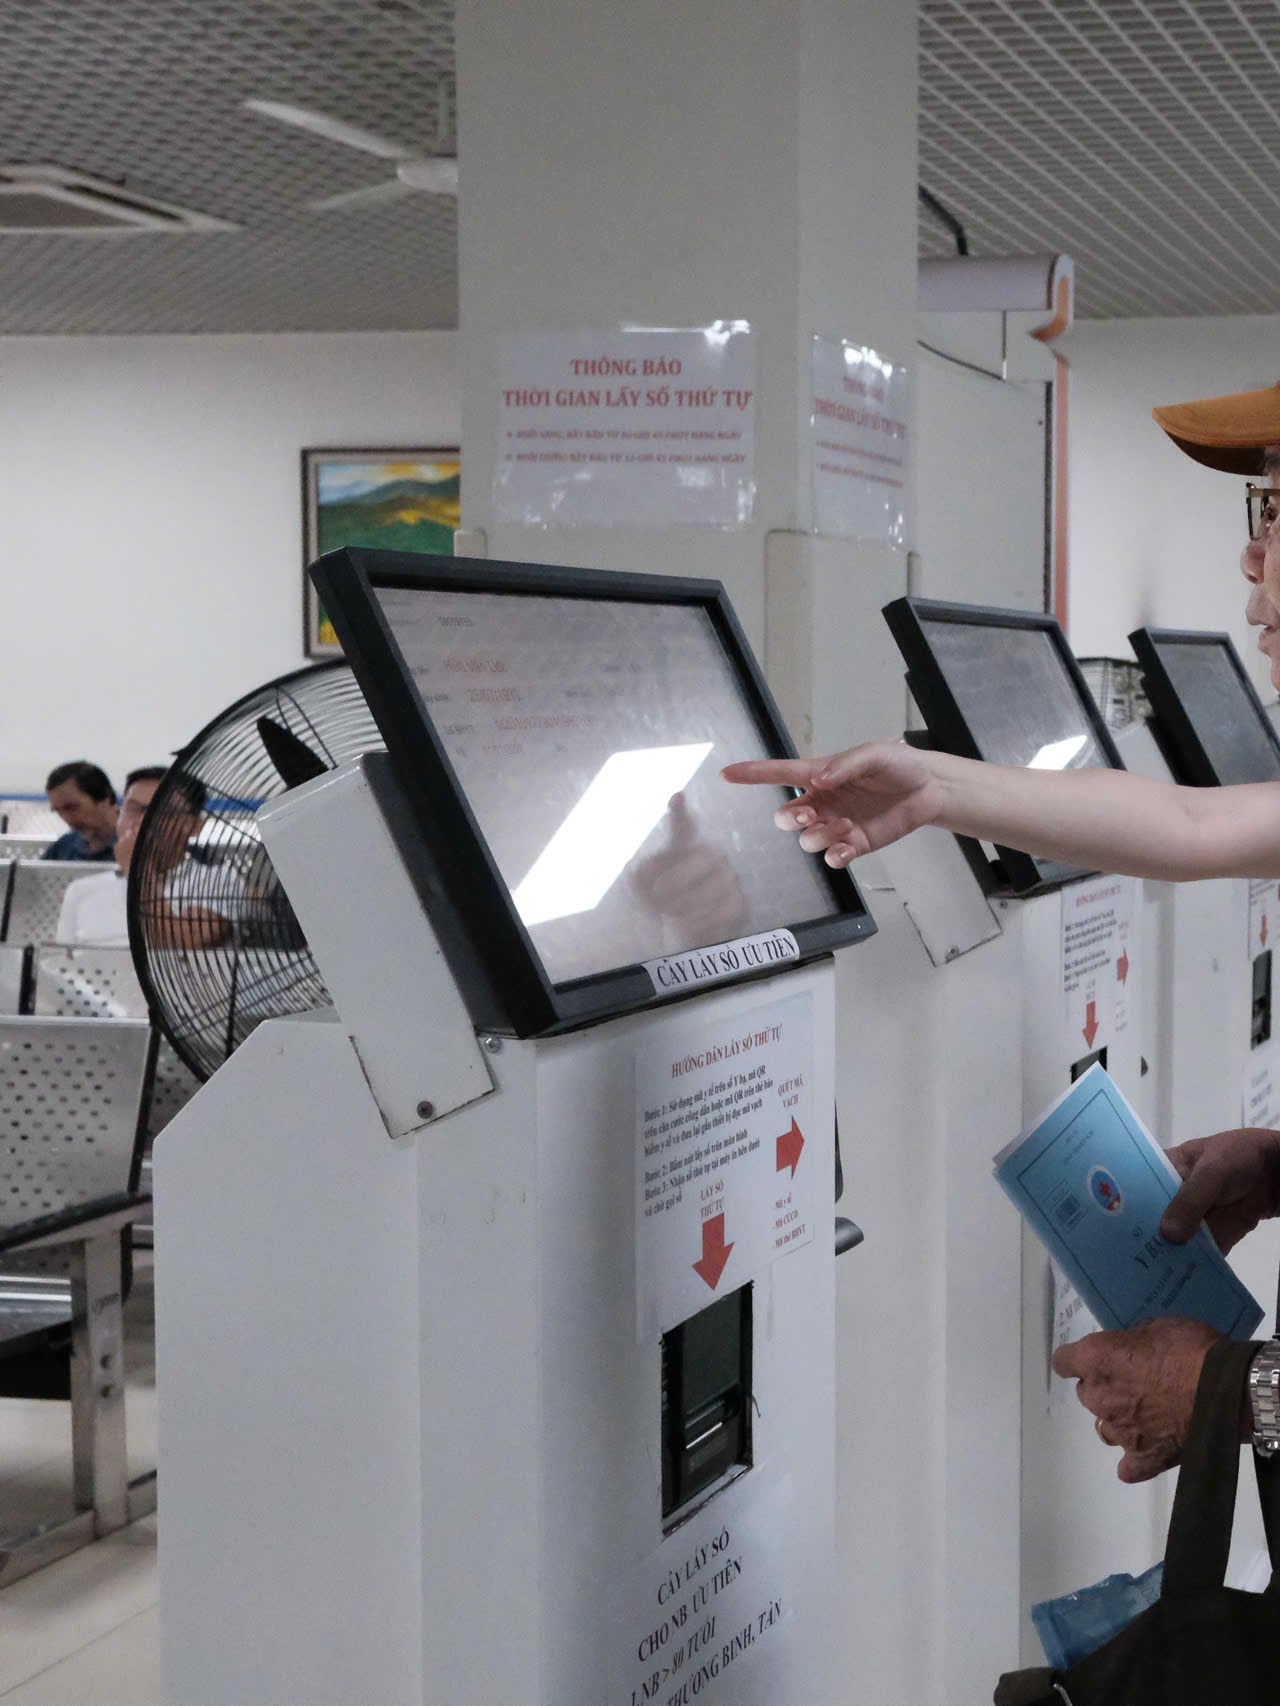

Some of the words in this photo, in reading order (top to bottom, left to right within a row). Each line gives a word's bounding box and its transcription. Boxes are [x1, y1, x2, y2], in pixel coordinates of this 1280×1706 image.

[570, 355, 637, 376] THÔNG
[642, 354, 682, 376] BÁO
[503, 386, 552, 407] THỜI
[555, 390, 600, 407] GIAN
[605, 385, 641, 407] LẤY
[646, 385, 670, 407] SỐ
[674, 386, 718, 407] THỨ
[722, 389, 754, 410] TỰ
[671, 1054, 704, 1078] HƯỚNG
[706, 1045, 723, 1066] DẪN
[725, 1039, 741, 1058] LẤY
[742, 1032, 753, 1051] SỐ
[754, 1026, 771, 1047] THỨ
[771, 1023, 783, 1042] TỰ
[714, 1082, 726, 1094] trên
[748, 1069, 756, 1081] mã
[756, 1065, 766, 1078] QR
[734, 1089, 743, 1104] QR
[742, 1102, 750, 1115] mã
[751, 1097, 763, 1112] vạch
[711, 1140, 722, 1153] trên
[658, 1567, 682, 1605] CÂY
[711, 1525, 729, 1558] SỐ
[638, 1622, 669, 1662] CHO
[671, 1604, 688, 1631] NB
[711, 1555, 743, 1594] TIÊN
[672, 1646, 684, 1674] 80
